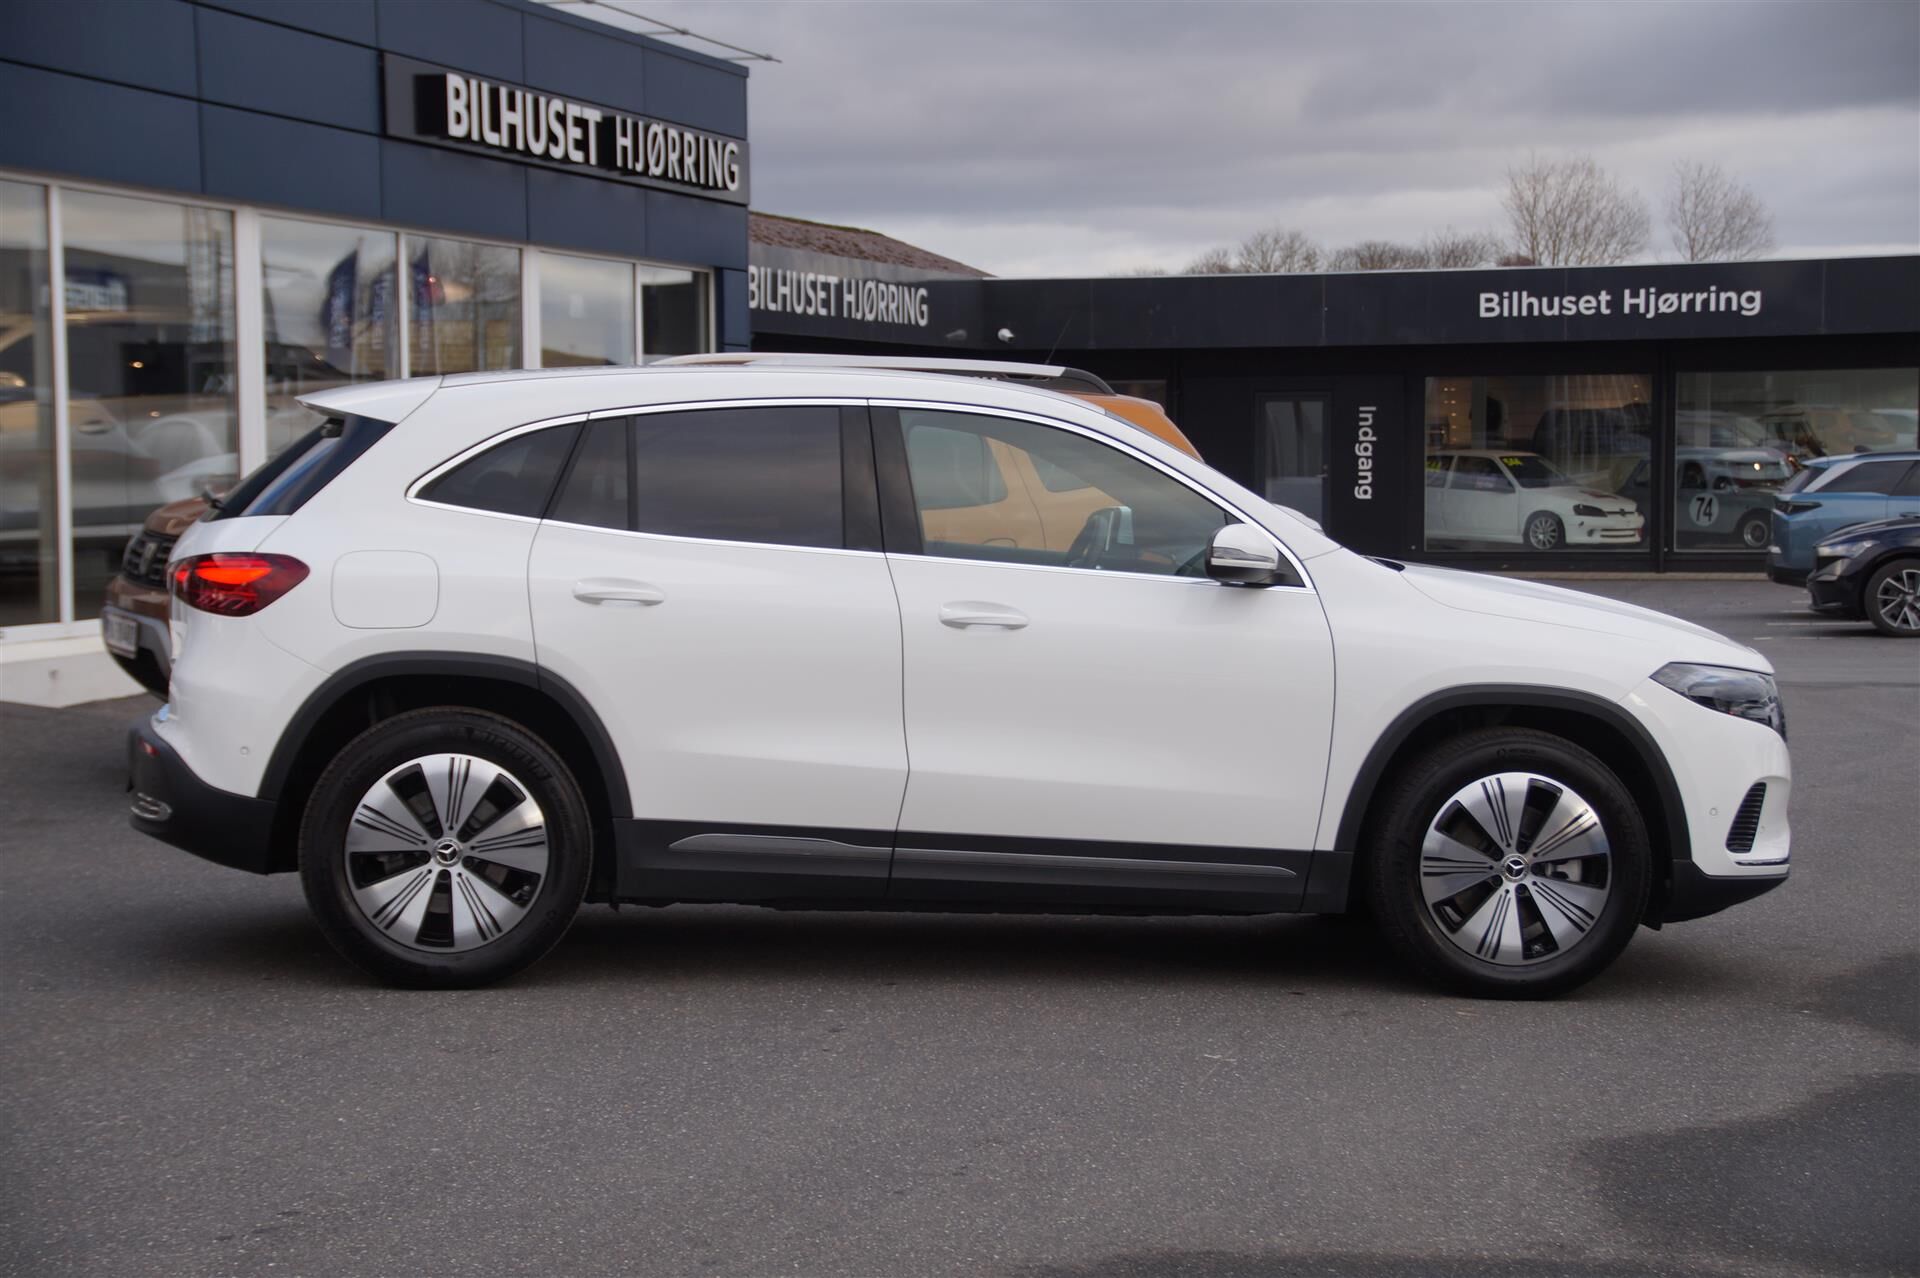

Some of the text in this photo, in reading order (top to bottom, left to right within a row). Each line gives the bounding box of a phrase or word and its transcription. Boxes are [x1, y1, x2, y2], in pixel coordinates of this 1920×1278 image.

[446, 73, 739, 191] BILHUSET HJØRRING
[748, 265, 928, 327] BILHUSET HJØRRING
[1479, 285, 1761, 319] Bilhuset Hjørring
[1354, 406, 1377, 499] Indgang
[1696, 497, 1712, 521] 74
